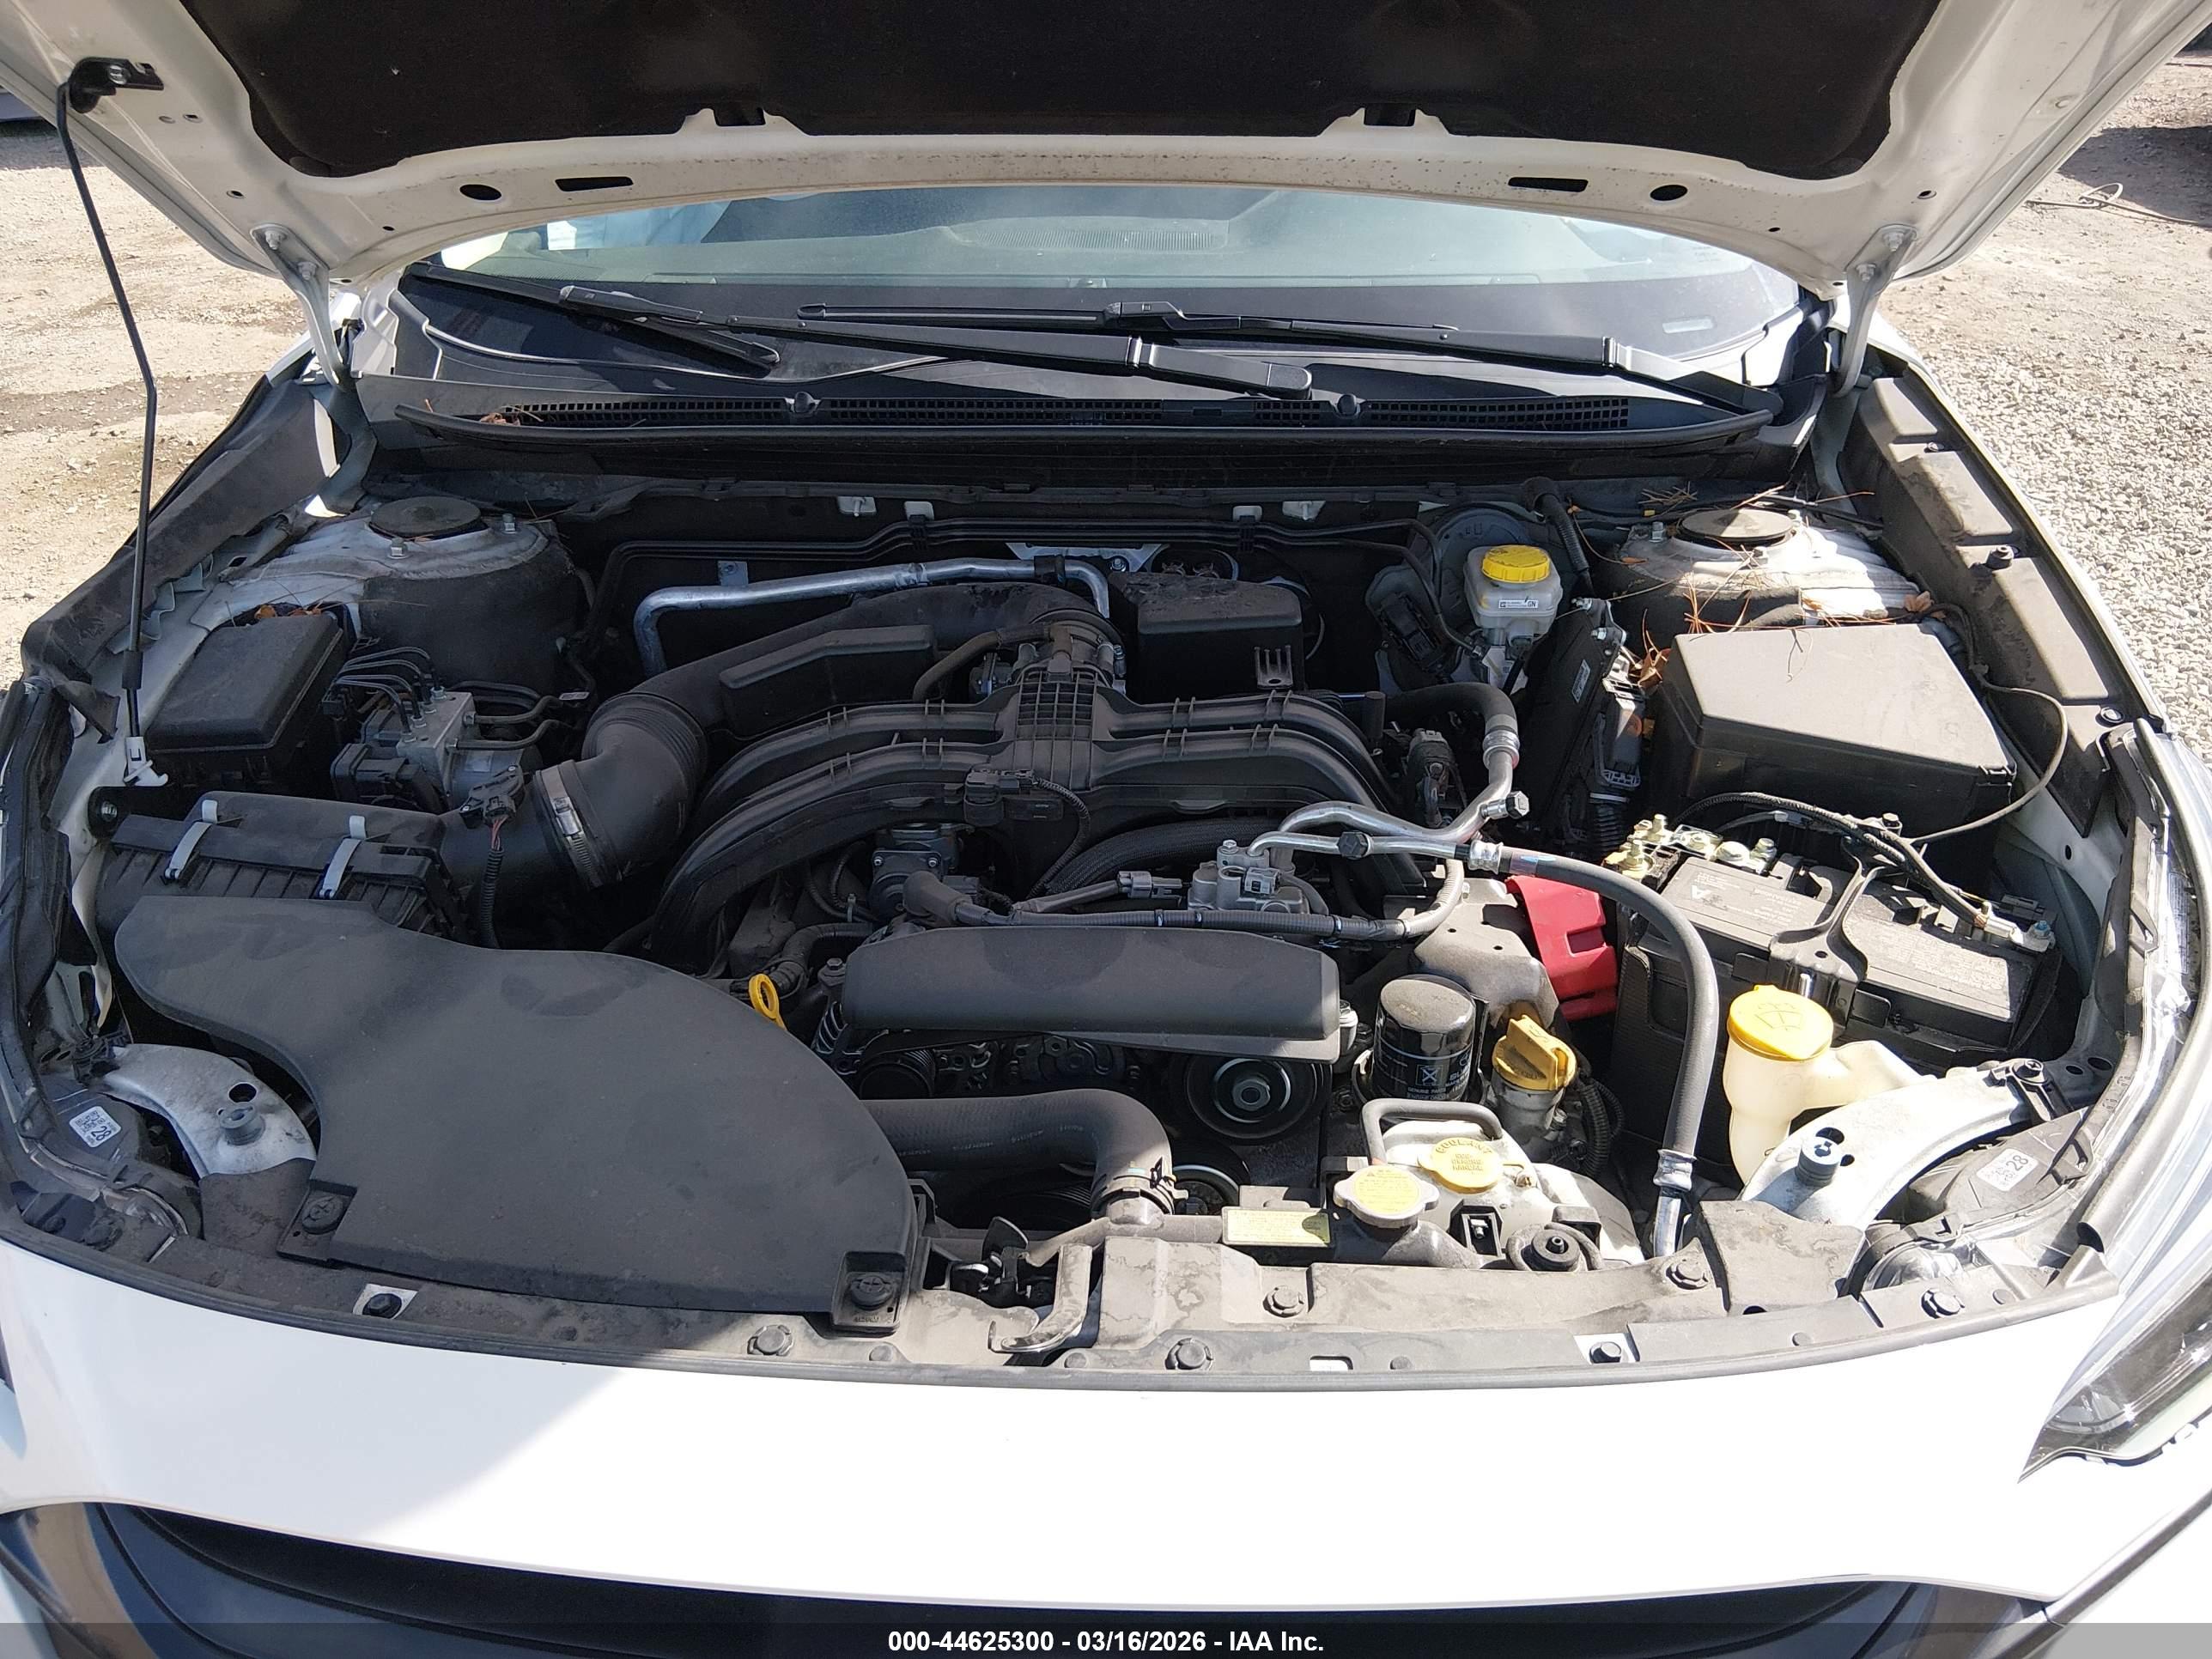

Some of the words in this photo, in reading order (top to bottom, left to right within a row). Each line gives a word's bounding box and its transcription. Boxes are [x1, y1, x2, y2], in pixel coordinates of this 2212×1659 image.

[91, 1126, 112, 1140] 28
[1435, 1139, 1492, 1153] COOLANT
[2005, 1155, 2028, 1171] 28
